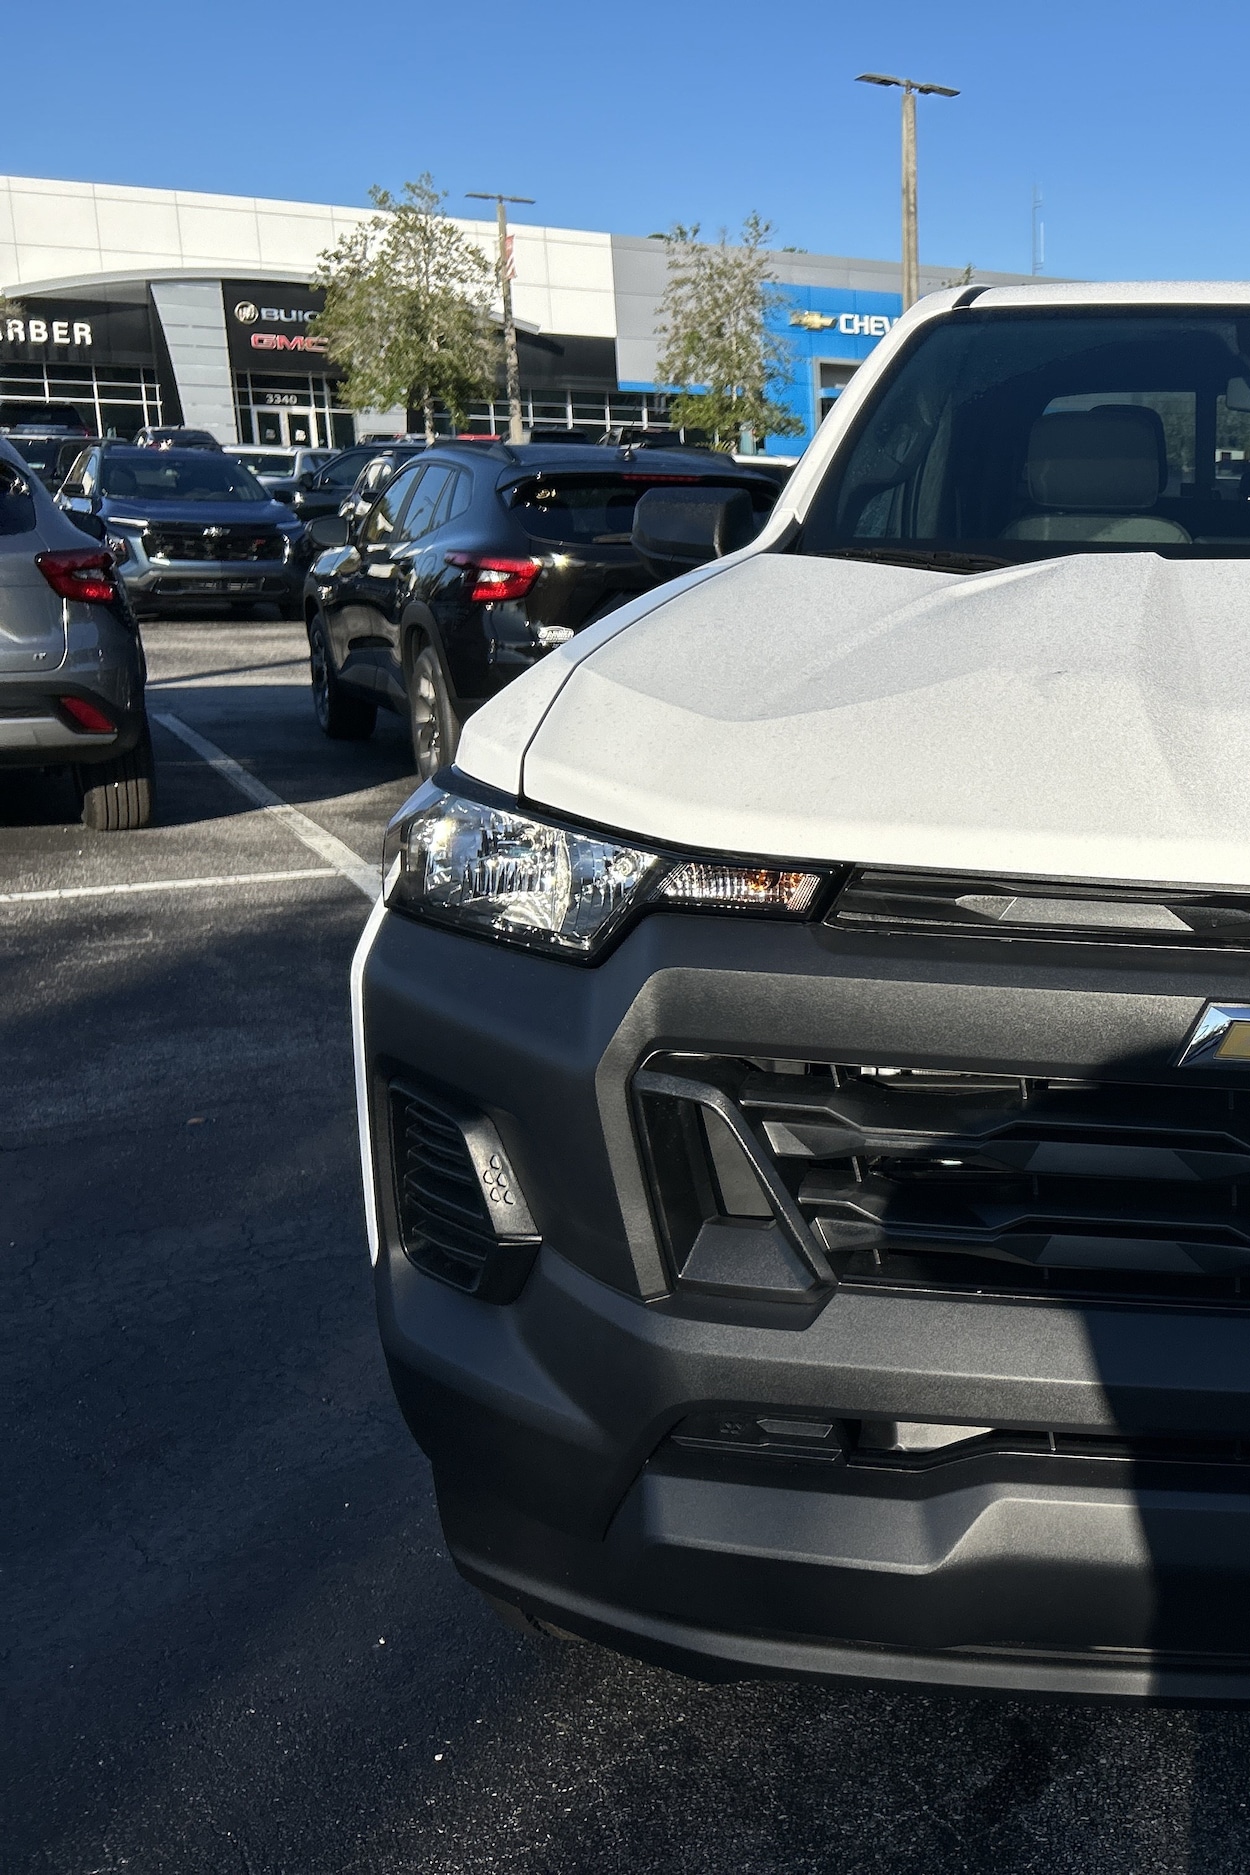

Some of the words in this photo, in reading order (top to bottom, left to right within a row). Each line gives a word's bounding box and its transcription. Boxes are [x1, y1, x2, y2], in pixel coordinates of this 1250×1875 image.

[260, 307, 320, 323] BUIC
[0, 319, 92, 345] RBER
[251, 333, 329, 352] GMC
[265, 393, 297, 405] 3340
